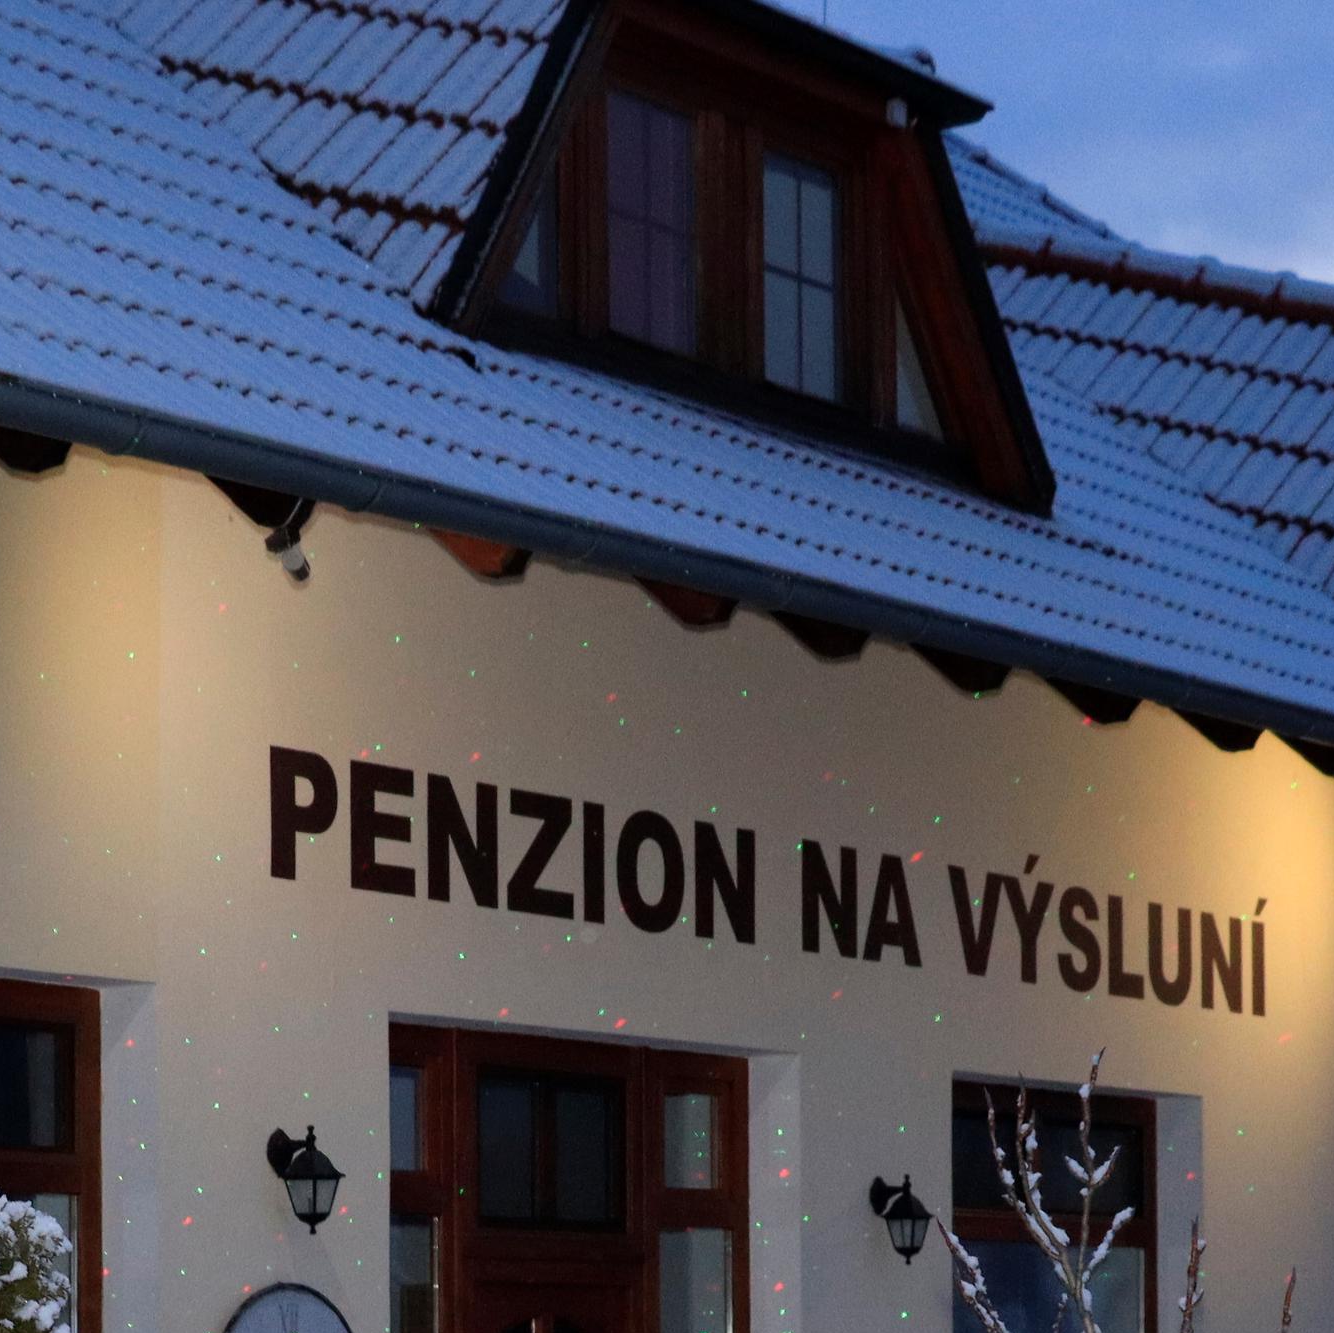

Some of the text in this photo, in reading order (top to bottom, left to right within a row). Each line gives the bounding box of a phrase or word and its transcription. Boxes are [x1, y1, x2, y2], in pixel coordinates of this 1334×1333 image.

[270, 745, 1267, 1017] PENZION NA VÝSLUNÍ
